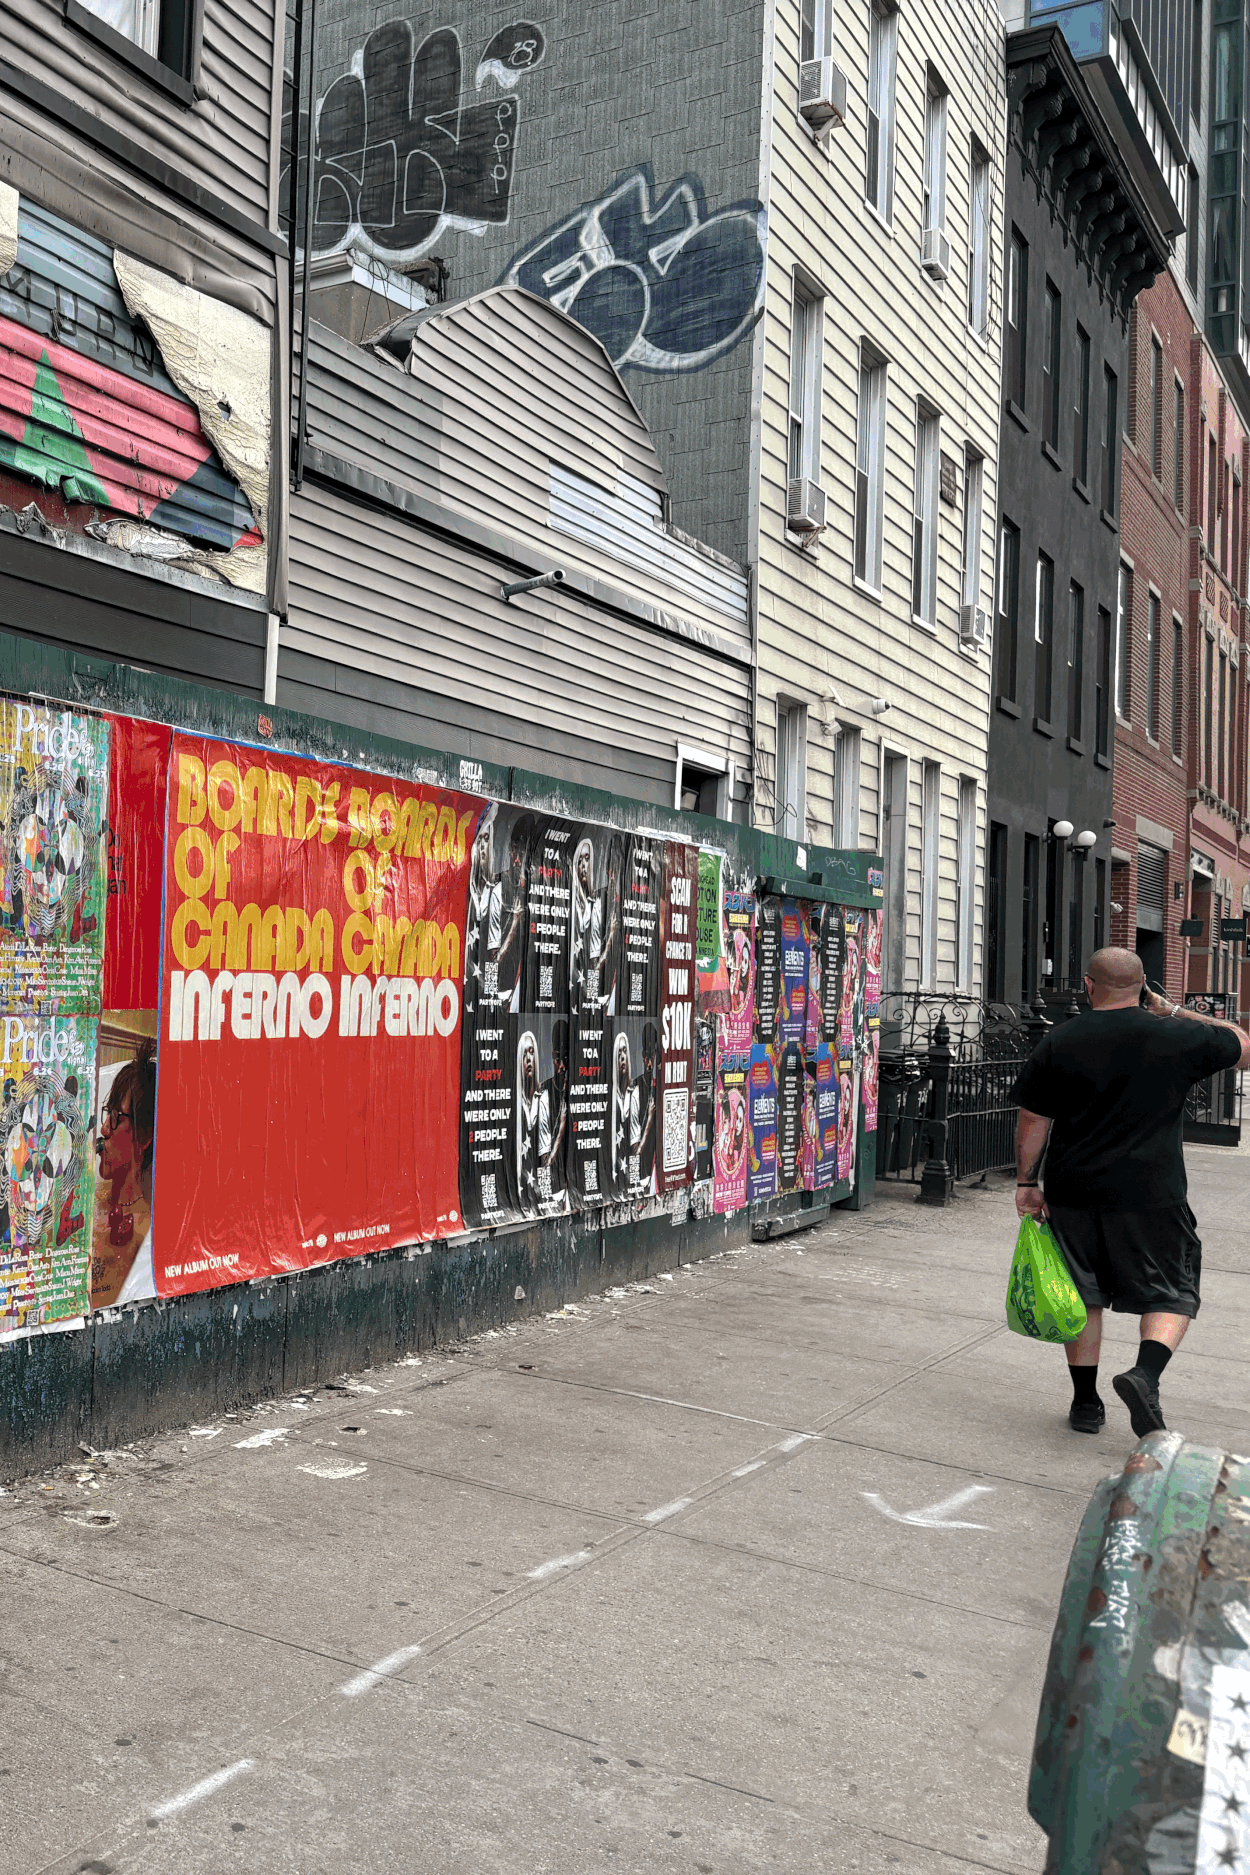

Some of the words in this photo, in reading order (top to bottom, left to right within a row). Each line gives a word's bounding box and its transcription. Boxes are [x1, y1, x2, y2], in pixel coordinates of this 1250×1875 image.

[12, 703, 82, 760] Pride
[177, 752, 341, 844] BOARDS
[348, 786, 474, 866] BOARDS
[550, 830, 571, 843] WENT
[544, 848, 553, 860] TO
[637, 850, 653, 861] WENT
[174, 826, 241, 900] OF
[635, 867, 642, 877] TO
[343, 849, 393, 914] OF
[529, 884, 545, 896] AND
[546, 885, 570, 900] THERE
[671, 876, 691, 907] SCAN
[528, 903, 550, 916] WERE
[550, 906, 570, 918] ONLY
[623, 899, 636, 910] AND
[637, 901, 656, 914] THERE
[537, 924, 566, 936] PEOPLE
[623, 916, 640, 927] WERE
[640, 918, 655, 930] ONLY
[672, 913, 683, 934] FOR
[683, 919, 688, 935] A
[172, 898, 334, 972] CANADA
[629, 935, 652, 946] PEOPLE
[342, 911, 460, 978] CANADA
[534, 942, 561, 955] THERE.
[666, 940, 686, 960] CHANCE
[686, 943, 692, 959] TO
[627, 952, 649, 963] THERE.
[668, 968, 688, 995] WIN
[169, 970, 333, 1041] INFERNO
[339, 974, 459, 1038] INFERNO
[479, 1029, 504, 1040] WENT
[662, 1002, 692, 1053] $10K
[0, 1016, 70, 1064] Pride
[582, 1030, 603, 1040] WENT
[480, 1050, 492, 1060] TO
[583, 1048, 592, 1058] TO
[475, 1069, 502, 1081] PARTY
[579, 1066, 601, 1076] PARTY
[665, 1062, 671, 1084] IN
[673, 1061, 688, 1083] RENT
[465, 1090, 484, 1102] AND
[484, 1088, 511, 1101] THERE
[570, 1084, 586, 1095] AND
[586, 1084, 608, 1094] THERE
[464, 1110, 489, 1122] WERE
[489, 1108, 511, 1120] ONLY
[570, 1103, 590, 1114] WERE
[590, 1102, 608, 1112] ONLY
[578, 1120, 604, 1131] PEOPLE
[474, 1128, 507, 1142] PEOPLE
[576, 1139, 602, 1150] THERE.
[473, 1149, 502, 1162] THERE.
[334, 1232, 346, 1243] NEW
[347, 1228, 365, 1241] ALBUM
[365, 1227, 376, 1237] OUT
[376, 1224, 390, 1235] NOW
[165, 1265, 182, 1278] NEW
[184, 1260, 208, 1274] ALBUM
[210, 1257, 222, 1270] OUT
[222, 1254, 239, 1267] NOW
